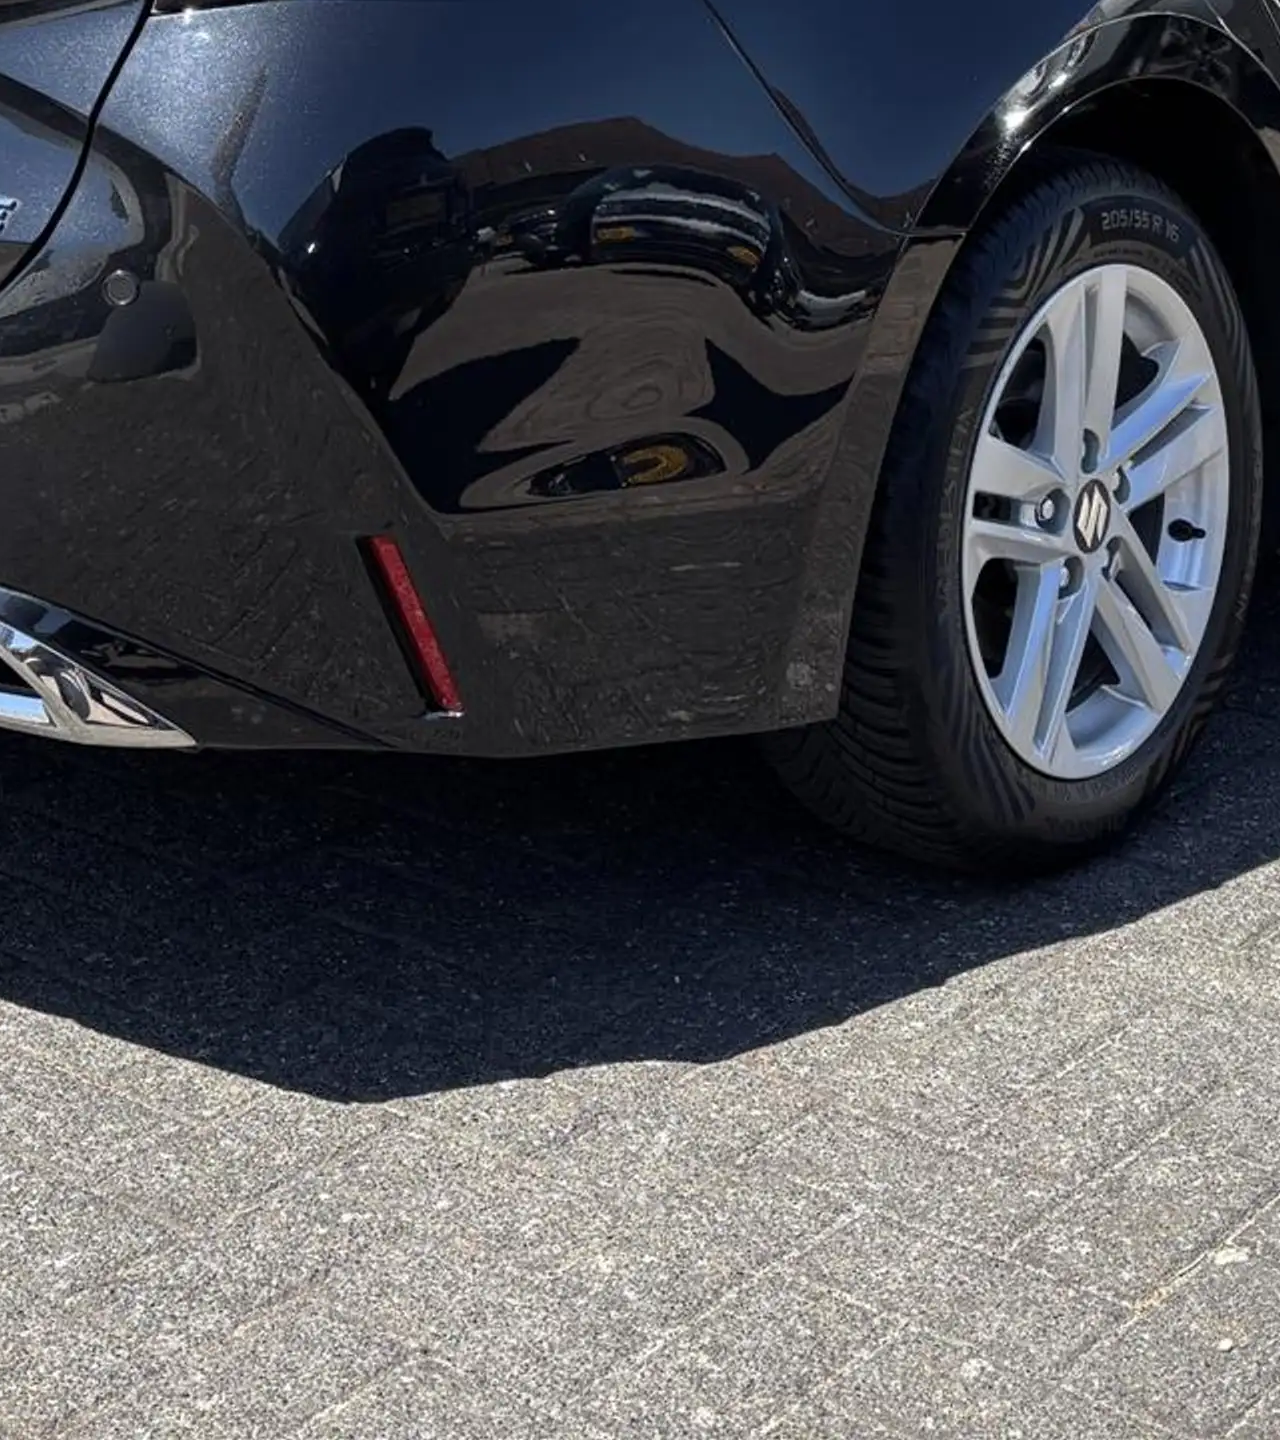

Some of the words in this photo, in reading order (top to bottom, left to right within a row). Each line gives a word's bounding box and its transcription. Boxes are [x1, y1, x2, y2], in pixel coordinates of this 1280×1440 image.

[1101, 207, 1150, 231] 205/55
[1152, 214, 1163, 235] R
[1165, 220, 1180, 243] 16
